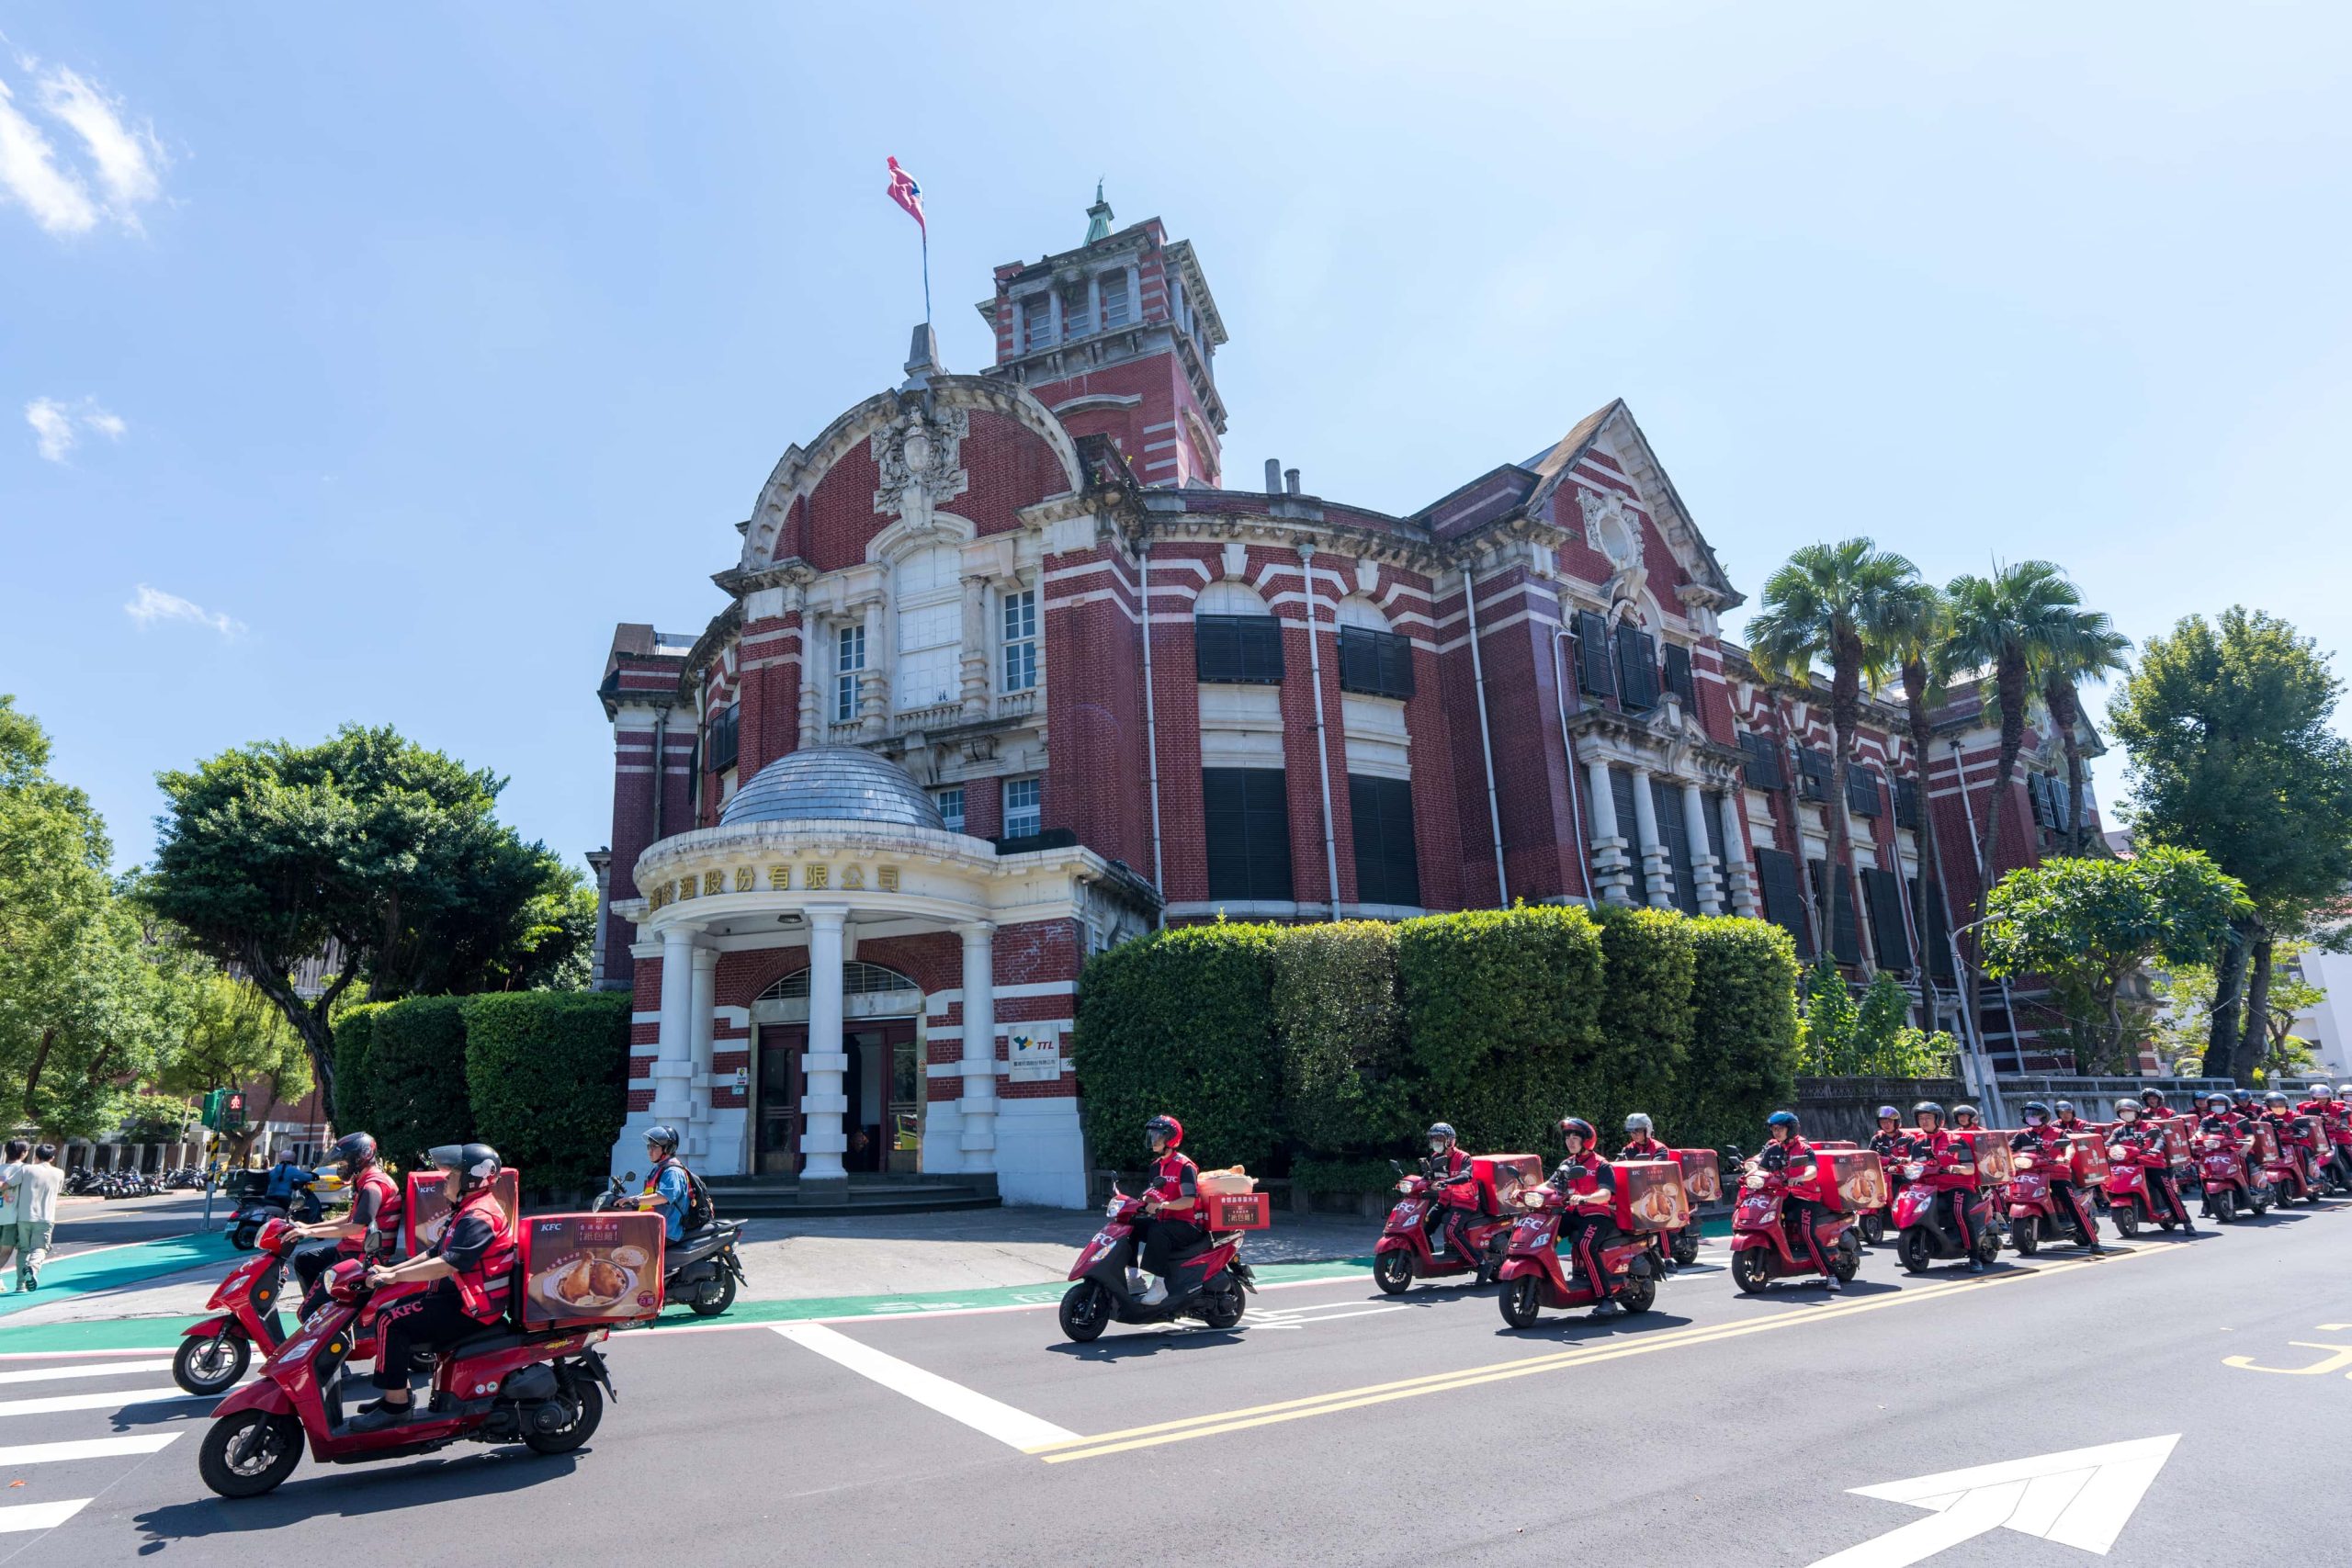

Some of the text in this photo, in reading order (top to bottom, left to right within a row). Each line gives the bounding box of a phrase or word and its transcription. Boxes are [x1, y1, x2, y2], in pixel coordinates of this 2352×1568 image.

[1037, 1042, 1054, 1050] TTL
[2205, 1156, 2231, 1165] KFC
[1740, 1198, 1770, 1210] KFC
[1515, 1216, 1544, 1231] KFC
[1802, 1209, 1811, 1225] KFC
[540, 1223, 562, 1232] KFC
[1584, 1224, 1598, 1240] KFC
[389, 1301, 424, 1321] KFC
